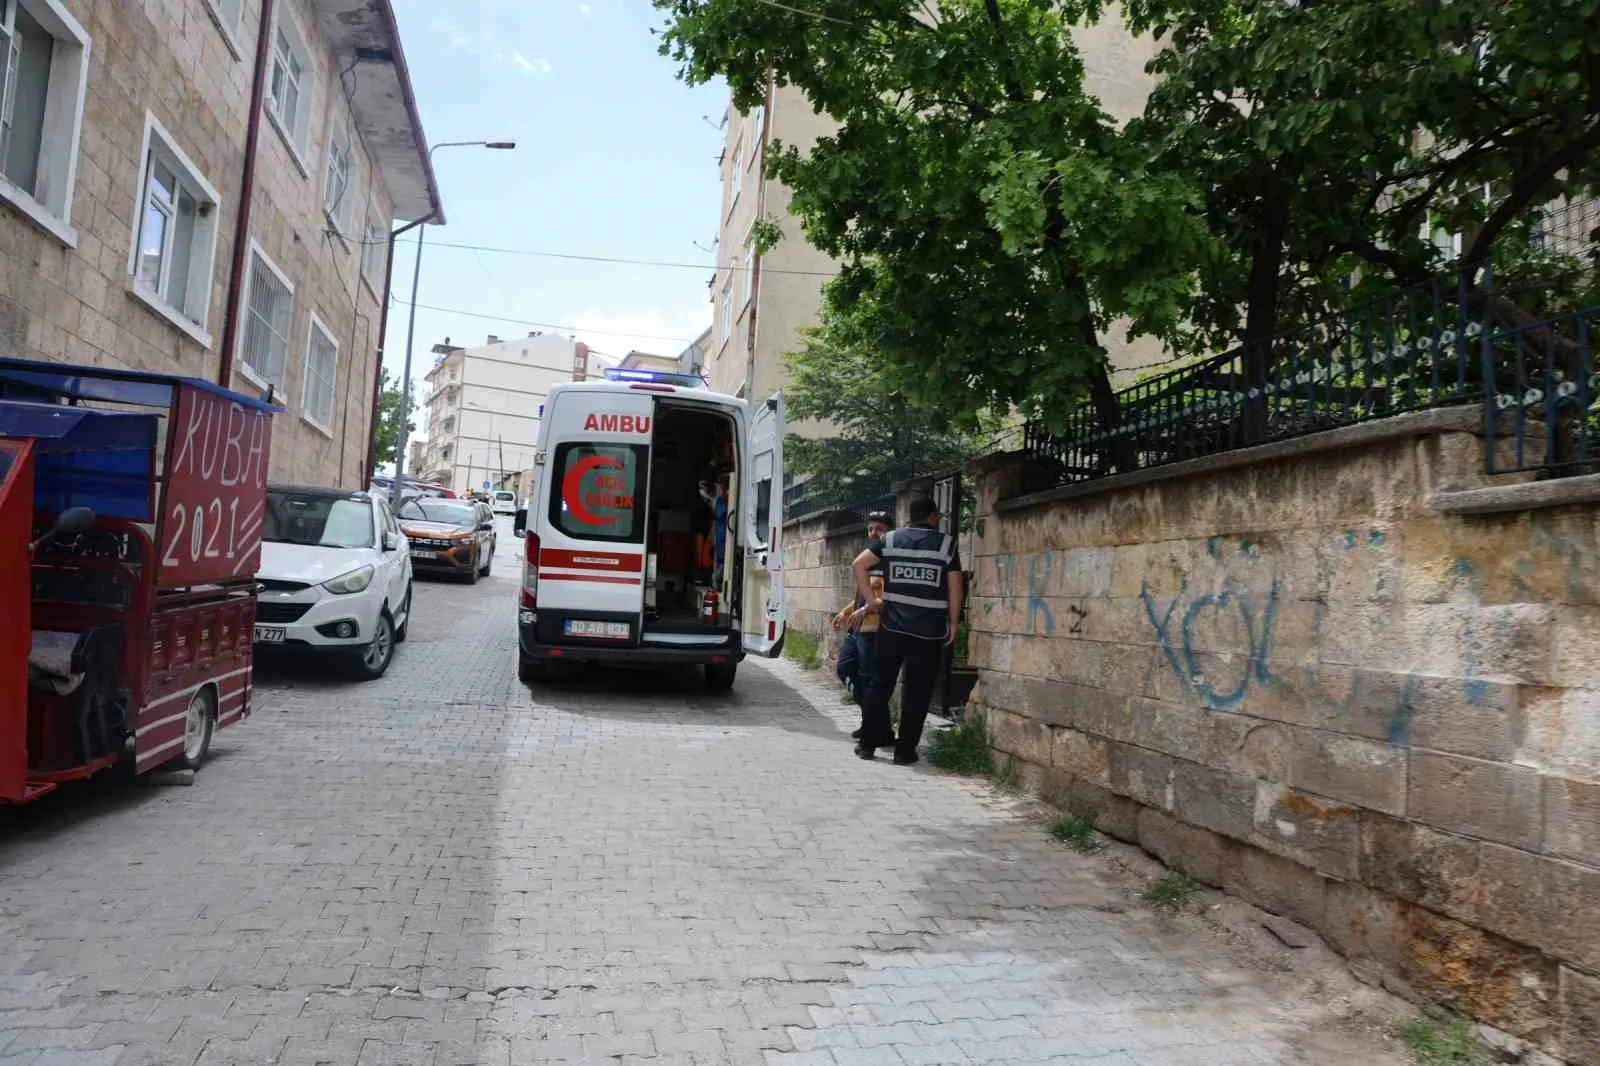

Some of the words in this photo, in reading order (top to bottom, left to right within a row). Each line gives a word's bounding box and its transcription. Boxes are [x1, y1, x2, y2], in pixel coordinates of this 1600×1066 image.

[174, 391, 264, 489] KUBA
[583, 413, 650, 433] AMBU
[162, 496, 240, 567] 2021
[263, 629, 284, 641] 277
